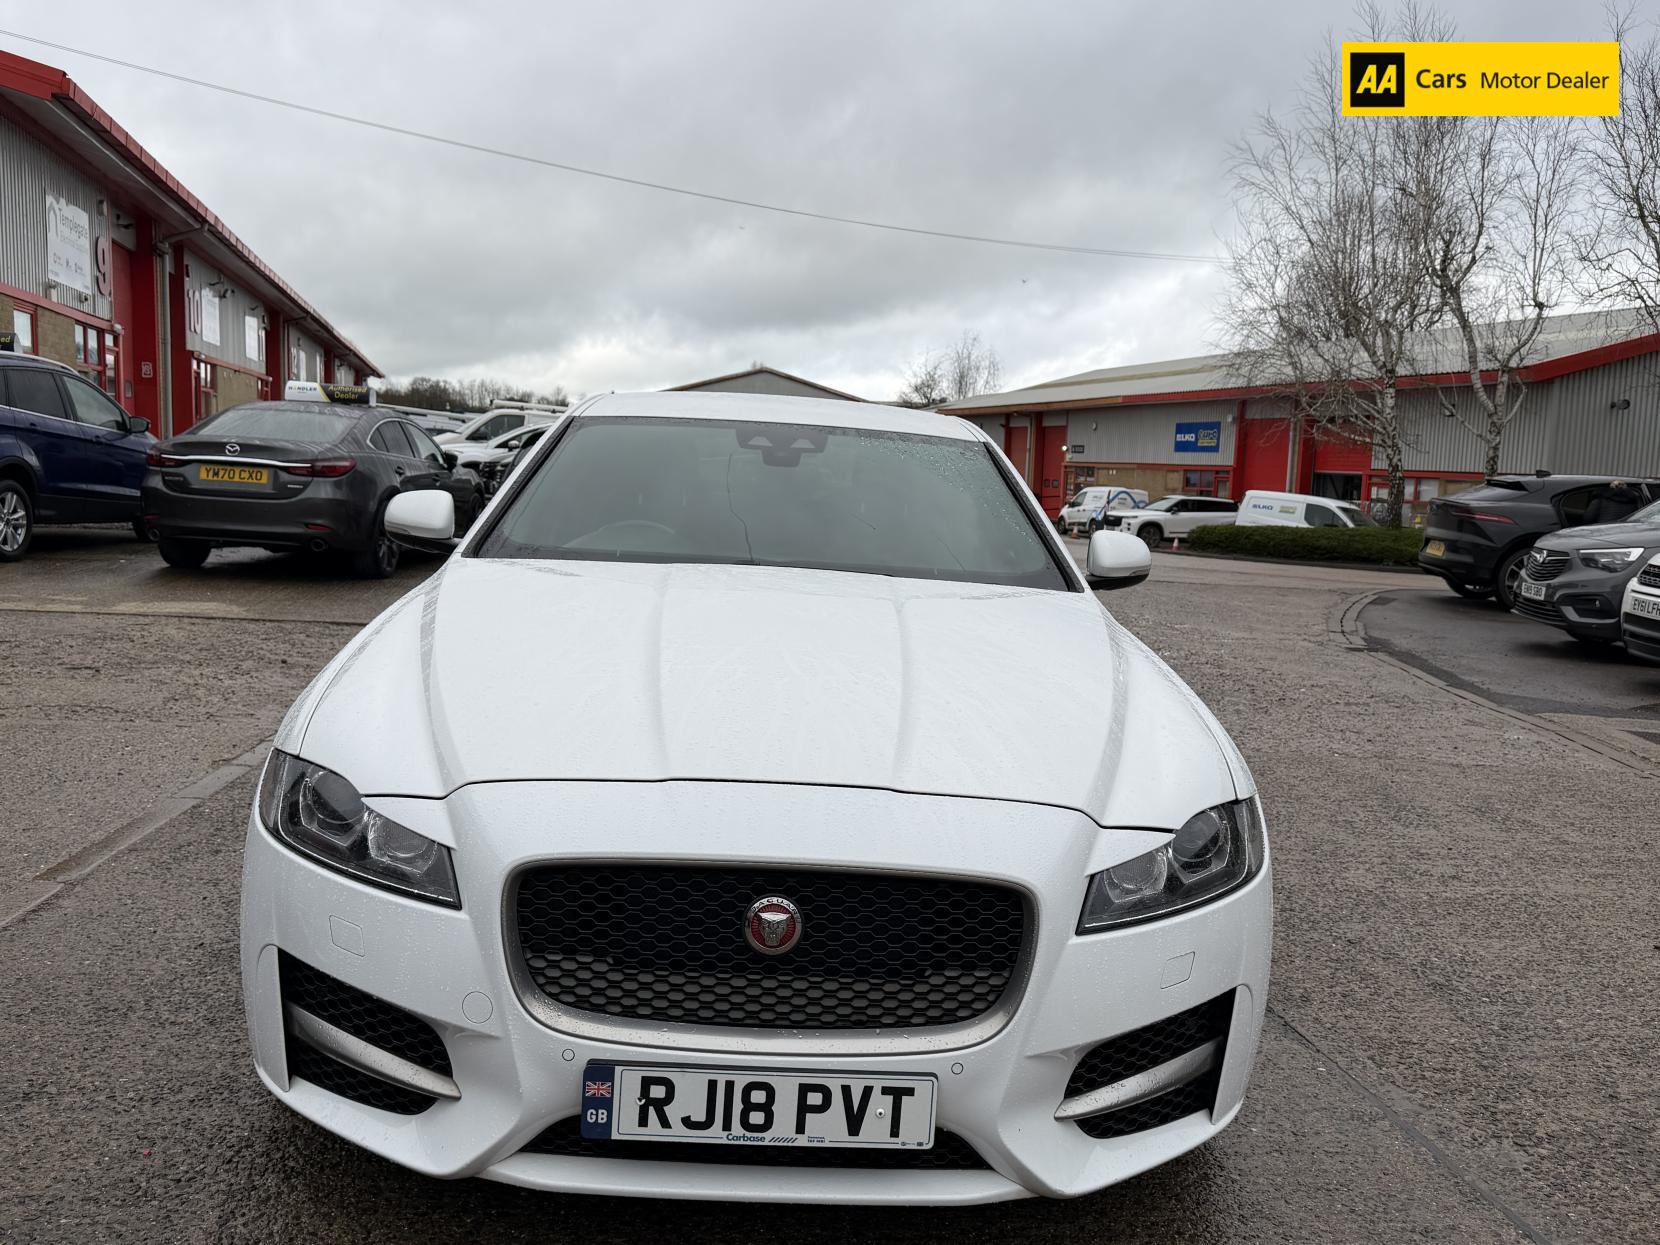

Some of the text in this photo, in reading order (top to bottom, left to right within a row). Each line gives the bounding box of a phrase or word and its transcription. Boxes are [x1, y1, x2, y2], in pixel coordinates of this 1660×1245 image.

[58, 207, 89, 241] Templegate
[95, 236, 112, 298] 9
[187, 288, 201, 335] 10
[328, 384, 368, 393] Authorised
[334, 391, 359, 400] Dealer
[203, 466, 236, 479] YM70
[751, 898, 798, 915] JAGUAR
[637, 1075, 916, 1139] RJ18 PVT
[586, 1108, 608, 1124] GB
[726, 1132, 766, 1144] Carbase
